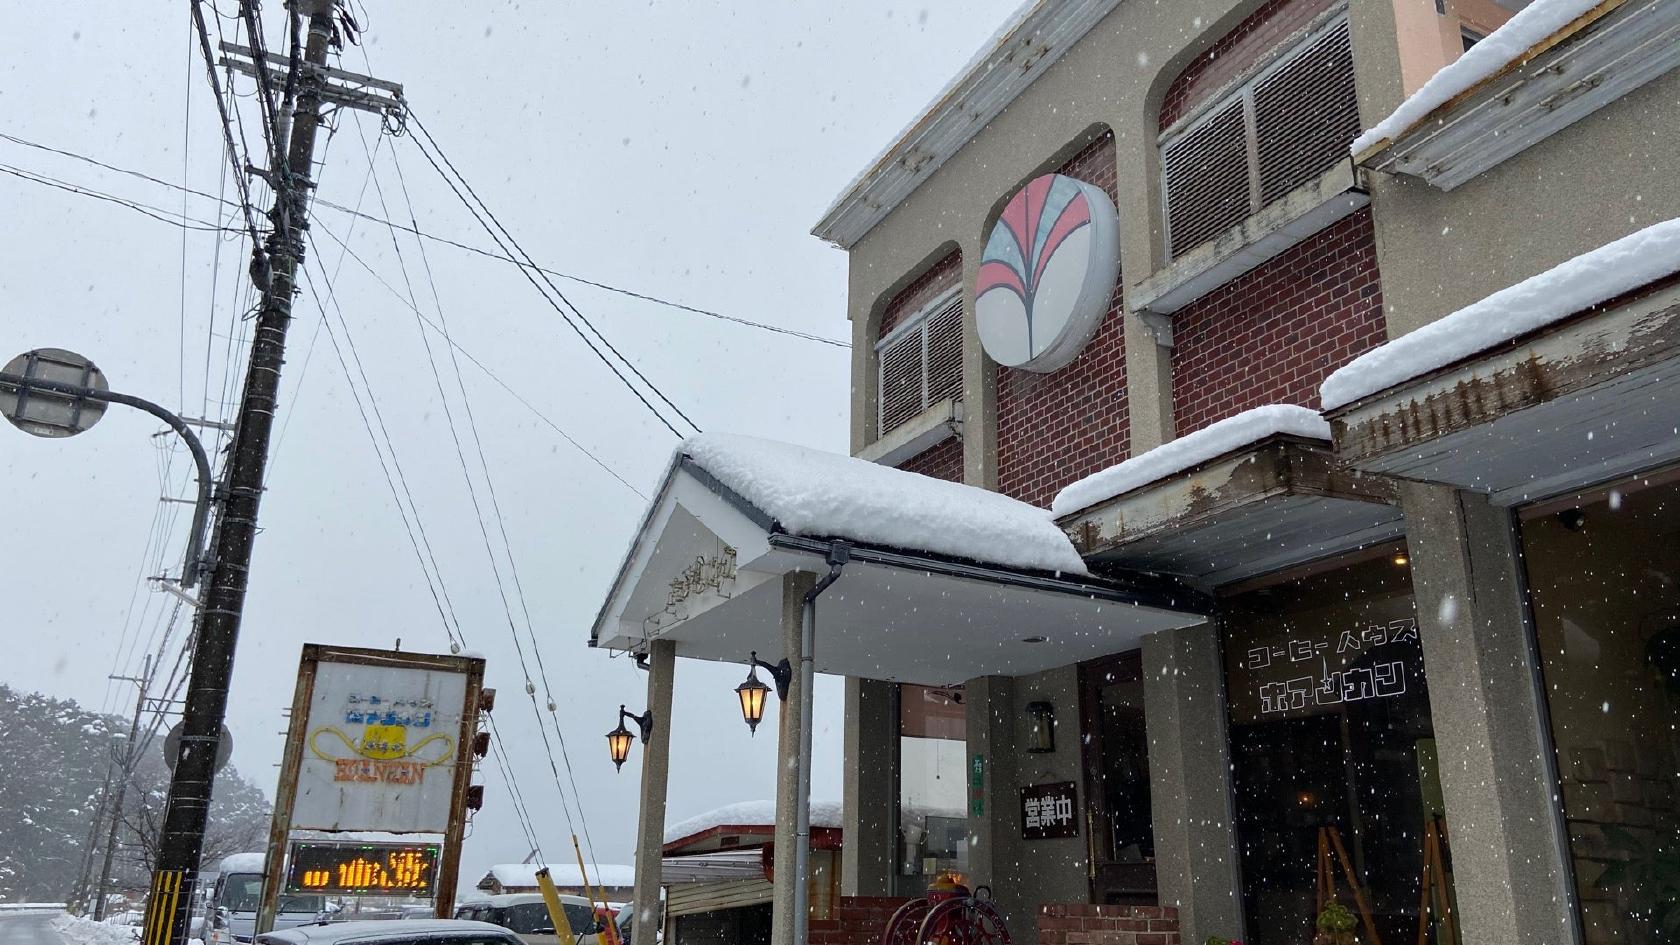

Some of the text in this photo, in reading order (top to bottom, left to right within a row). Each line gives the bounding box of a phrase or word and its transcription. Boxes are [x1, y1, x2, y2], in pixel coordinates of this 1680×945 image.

[1248, 617, 1418, 670] コーヒー ハウス
[1025, 794, 1072, 828] 営業中
